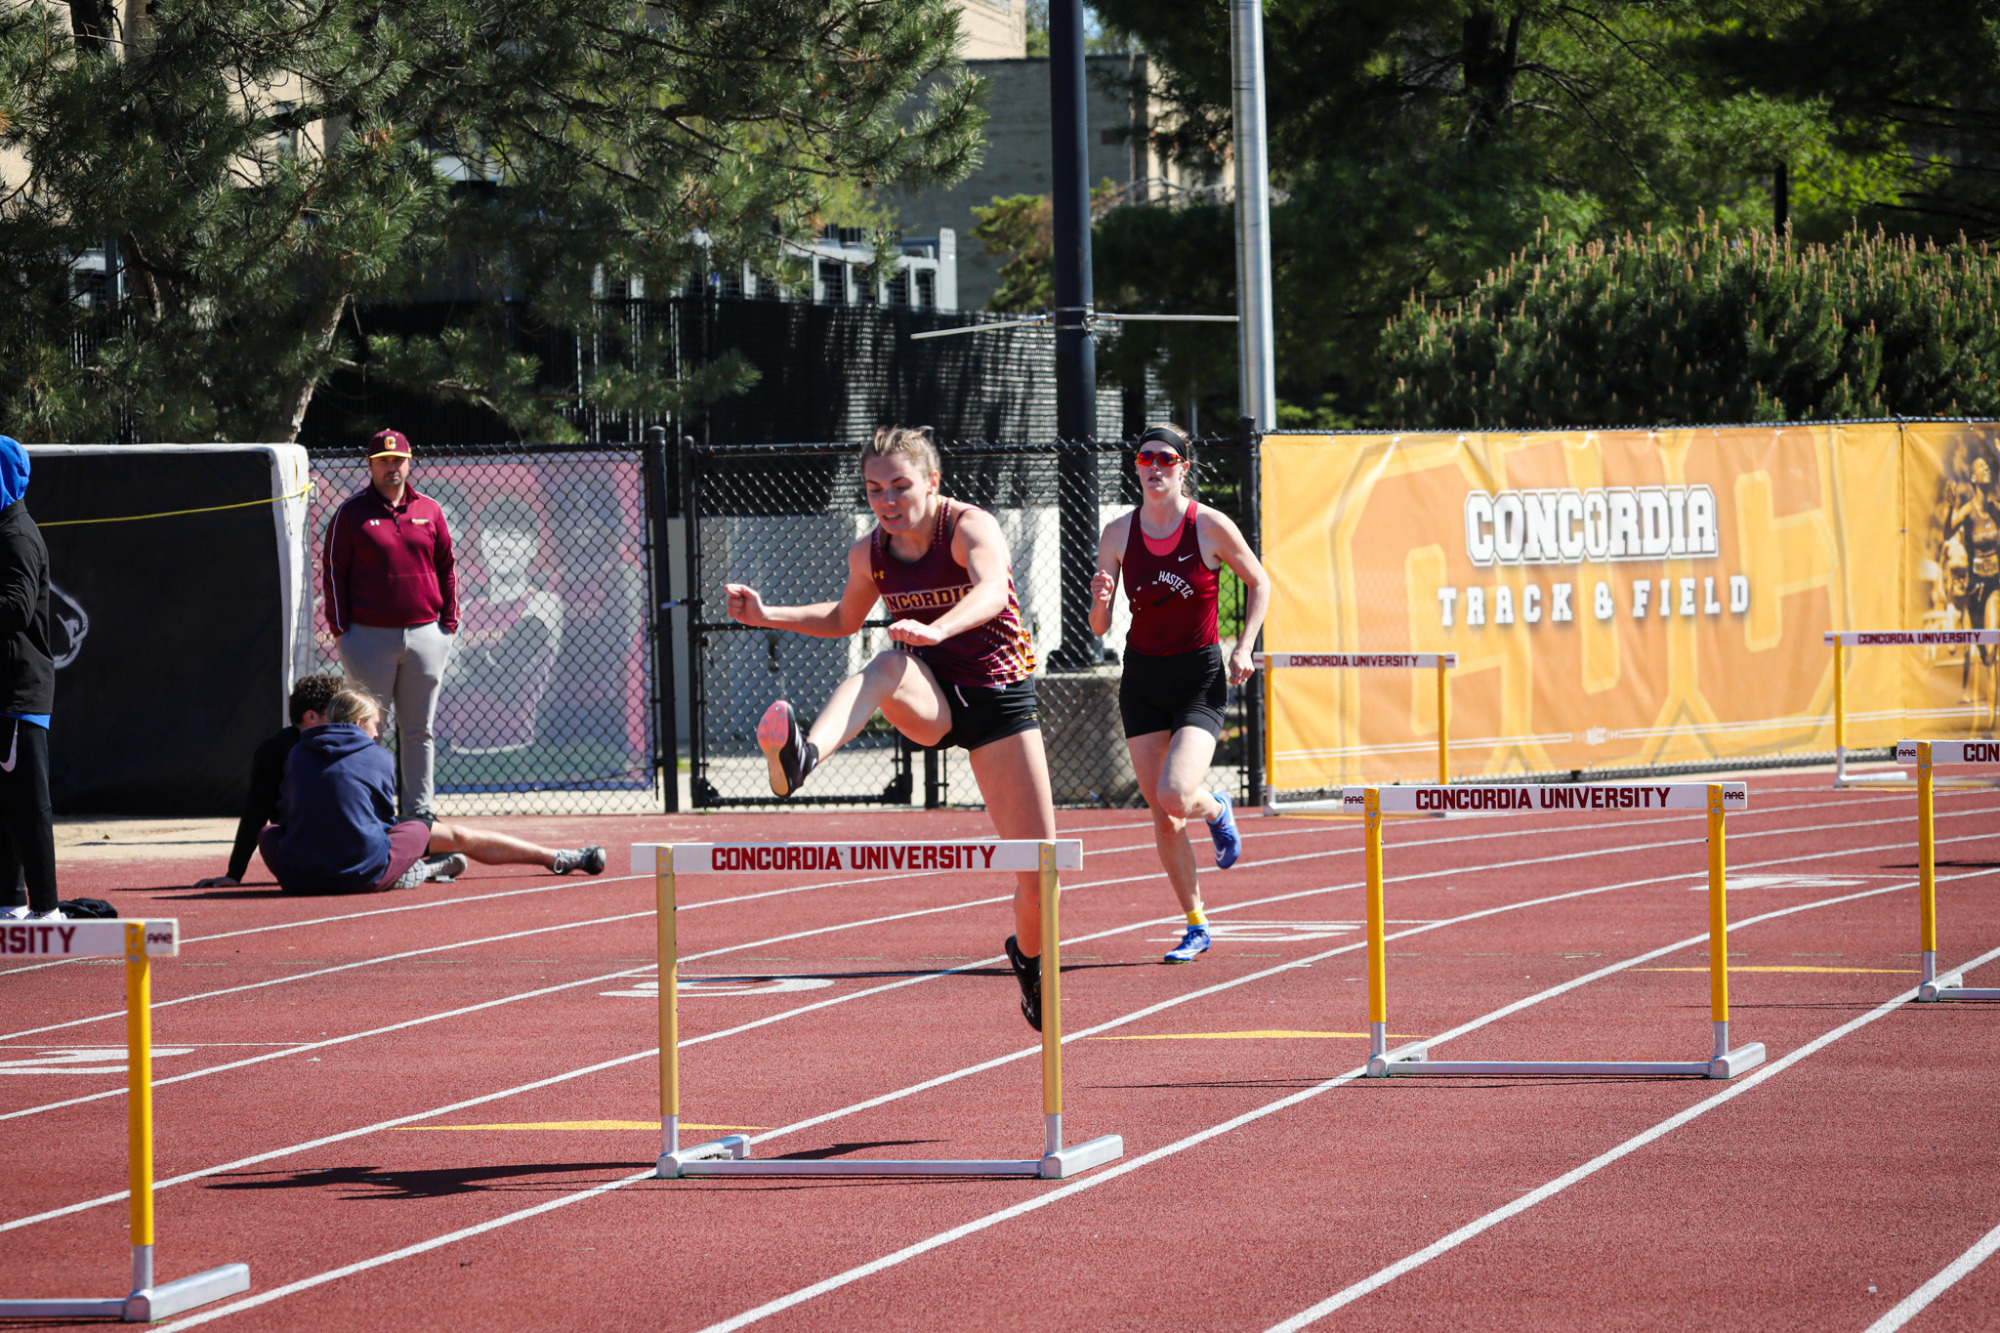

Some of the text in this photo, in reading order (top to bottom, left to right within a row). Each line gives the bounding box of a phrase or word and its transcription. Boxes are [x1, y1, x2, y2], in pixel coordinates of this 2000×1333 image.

[384, 436, 396, 450] C
[1464, 484, 1718, 566] CONCORDIA
[1158, 570, 1186, 590] HASTE
[1437, 575, 1749, 626] TRACK & FIELD
[1858, 632, 1981, 645] CONCORDIA UNIVERSITY
[1289, 655, 1418, 667] CONCORDIA UNIVERSITY
[1415, 787, 1671, 810] CONCORDIA UNIVERSITY
[711, 845, 996, 870] CONCORDIA UNIVERSITY
